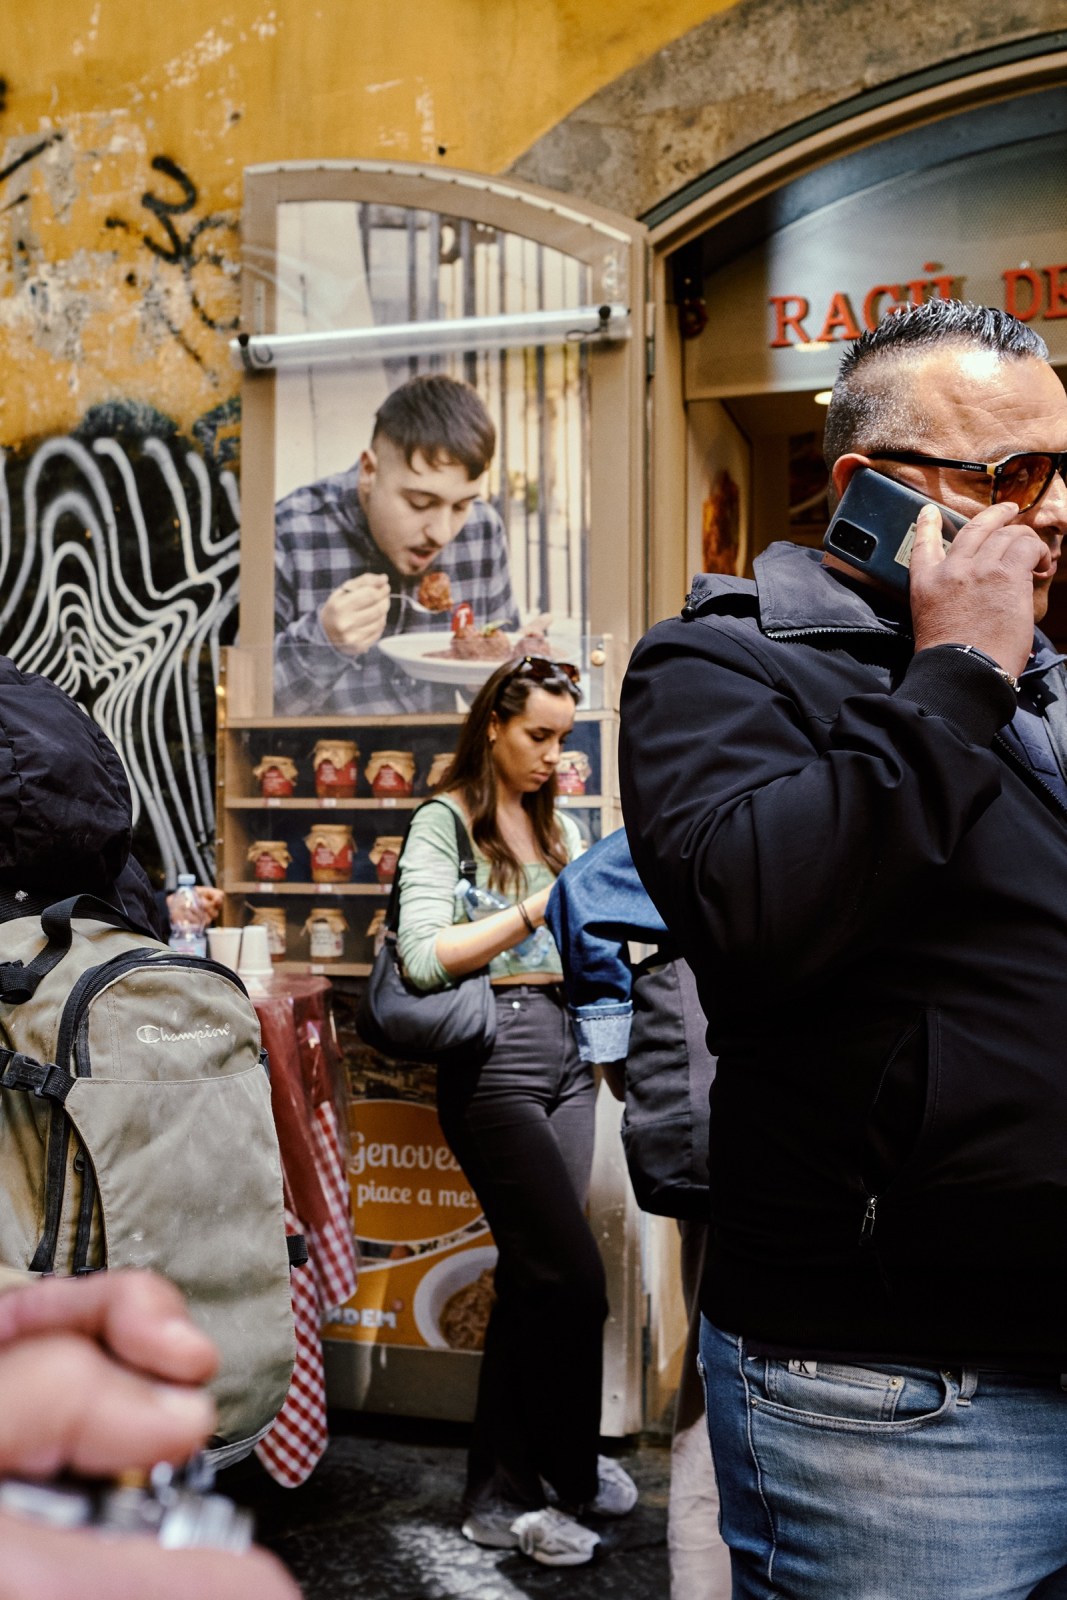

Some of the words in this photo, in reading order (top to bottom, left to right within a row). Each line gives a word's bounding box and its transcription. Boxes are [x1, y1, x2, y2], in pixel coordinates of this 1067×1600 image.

[136, 1024, 229, 1048] Champion
[357, 1180, 412, 1208] piace
[417, 1188, 432, 1205] a
